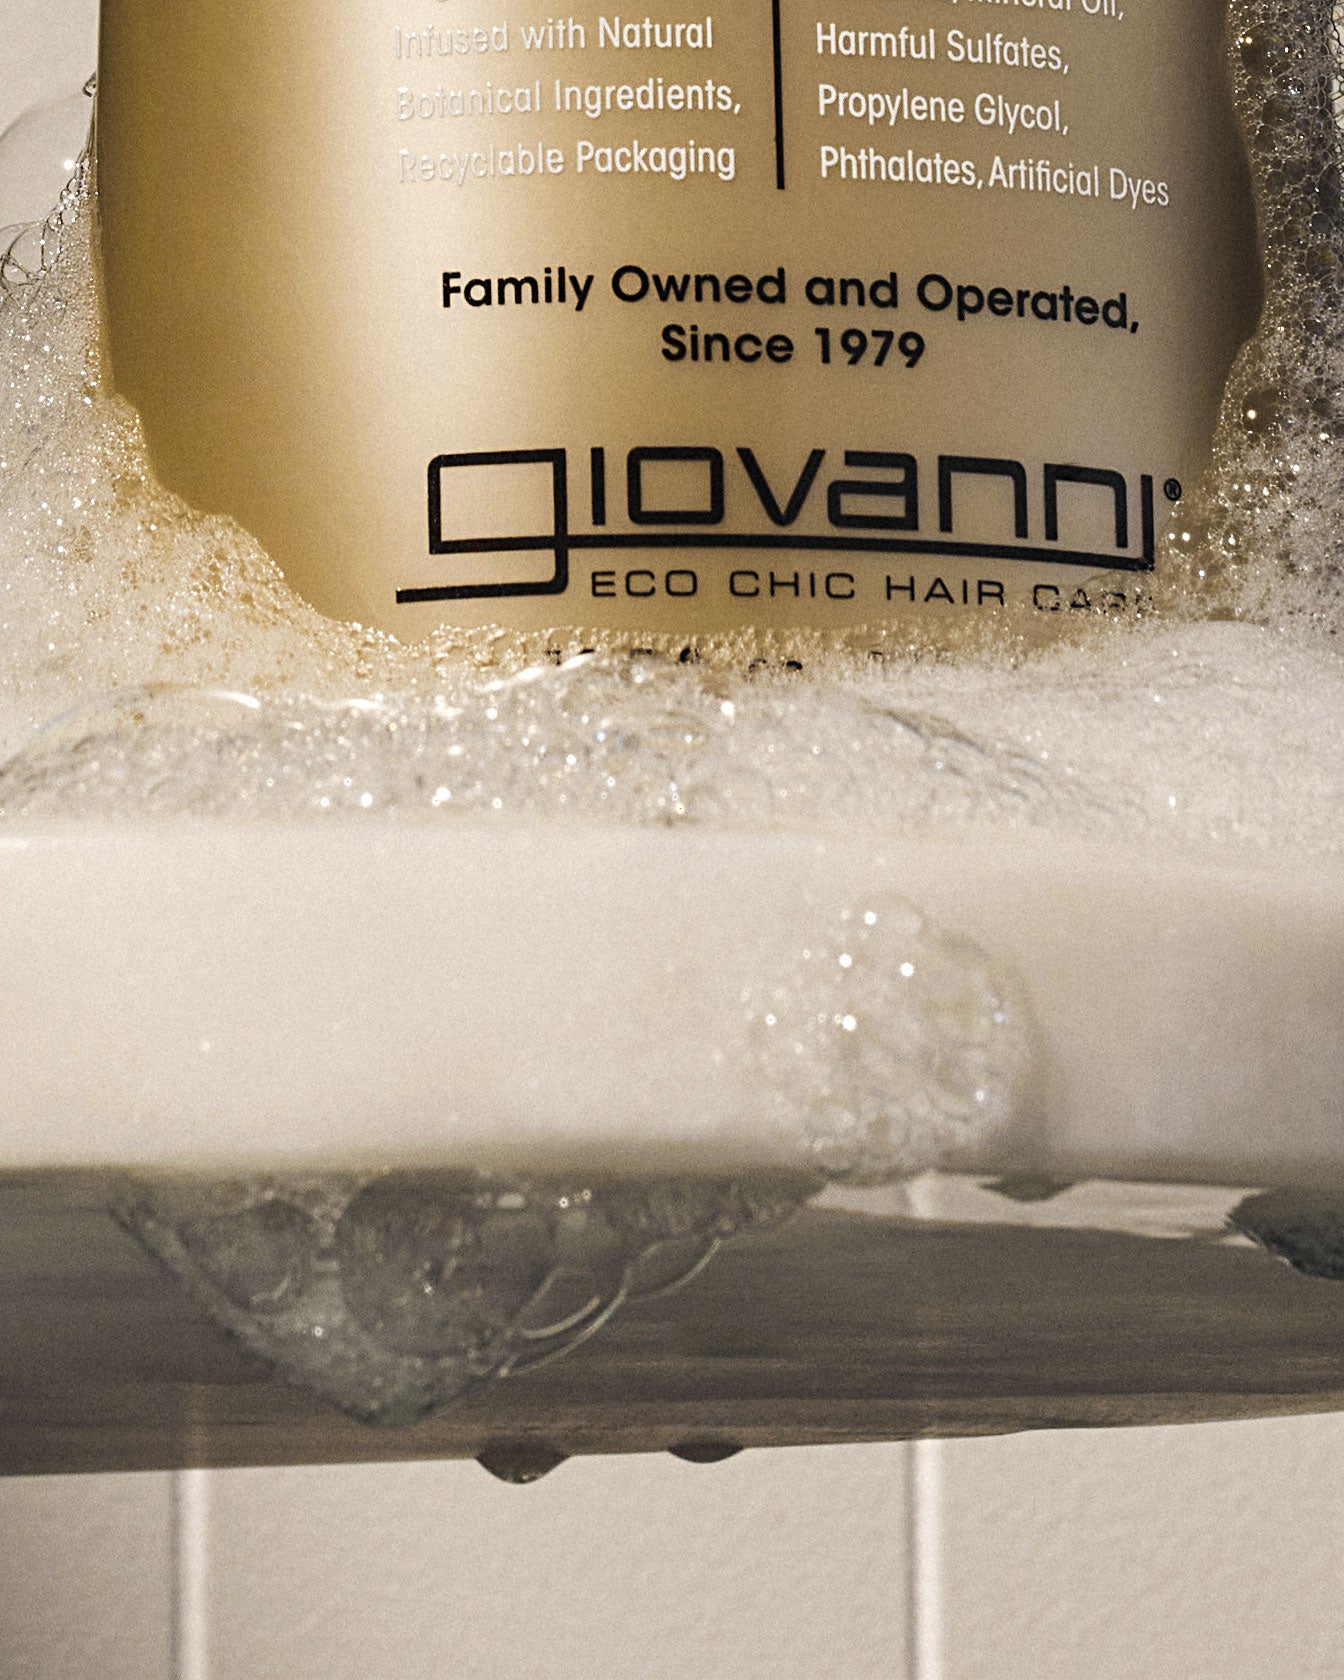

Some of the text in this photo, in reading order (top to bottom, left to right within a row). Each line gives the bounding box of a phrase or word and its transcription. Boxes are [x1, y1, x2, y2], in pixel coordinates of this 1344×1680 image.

[394, 16, 713, 59] Infused with Natural
[816, 22, 1069, 74] Harmful Sulfates,
[396, 78, 741, 120] Botanical Ingredients,
[819, 84, 1068, 136] Propylene Glycol,
[398, 140, 735, 185] Recyclable Packaging
[820, 145, 1169, 210] Phthalates, Artificial Dyes
[441, 265, 1139, 334] Family Owned and Operated,
[660, 325, 926, 368] Since 1979
[591, 569, 699, 600] ECO
[729, 570, 855, 601] CHIC
[885, 574, 1005, 608] HAIR
